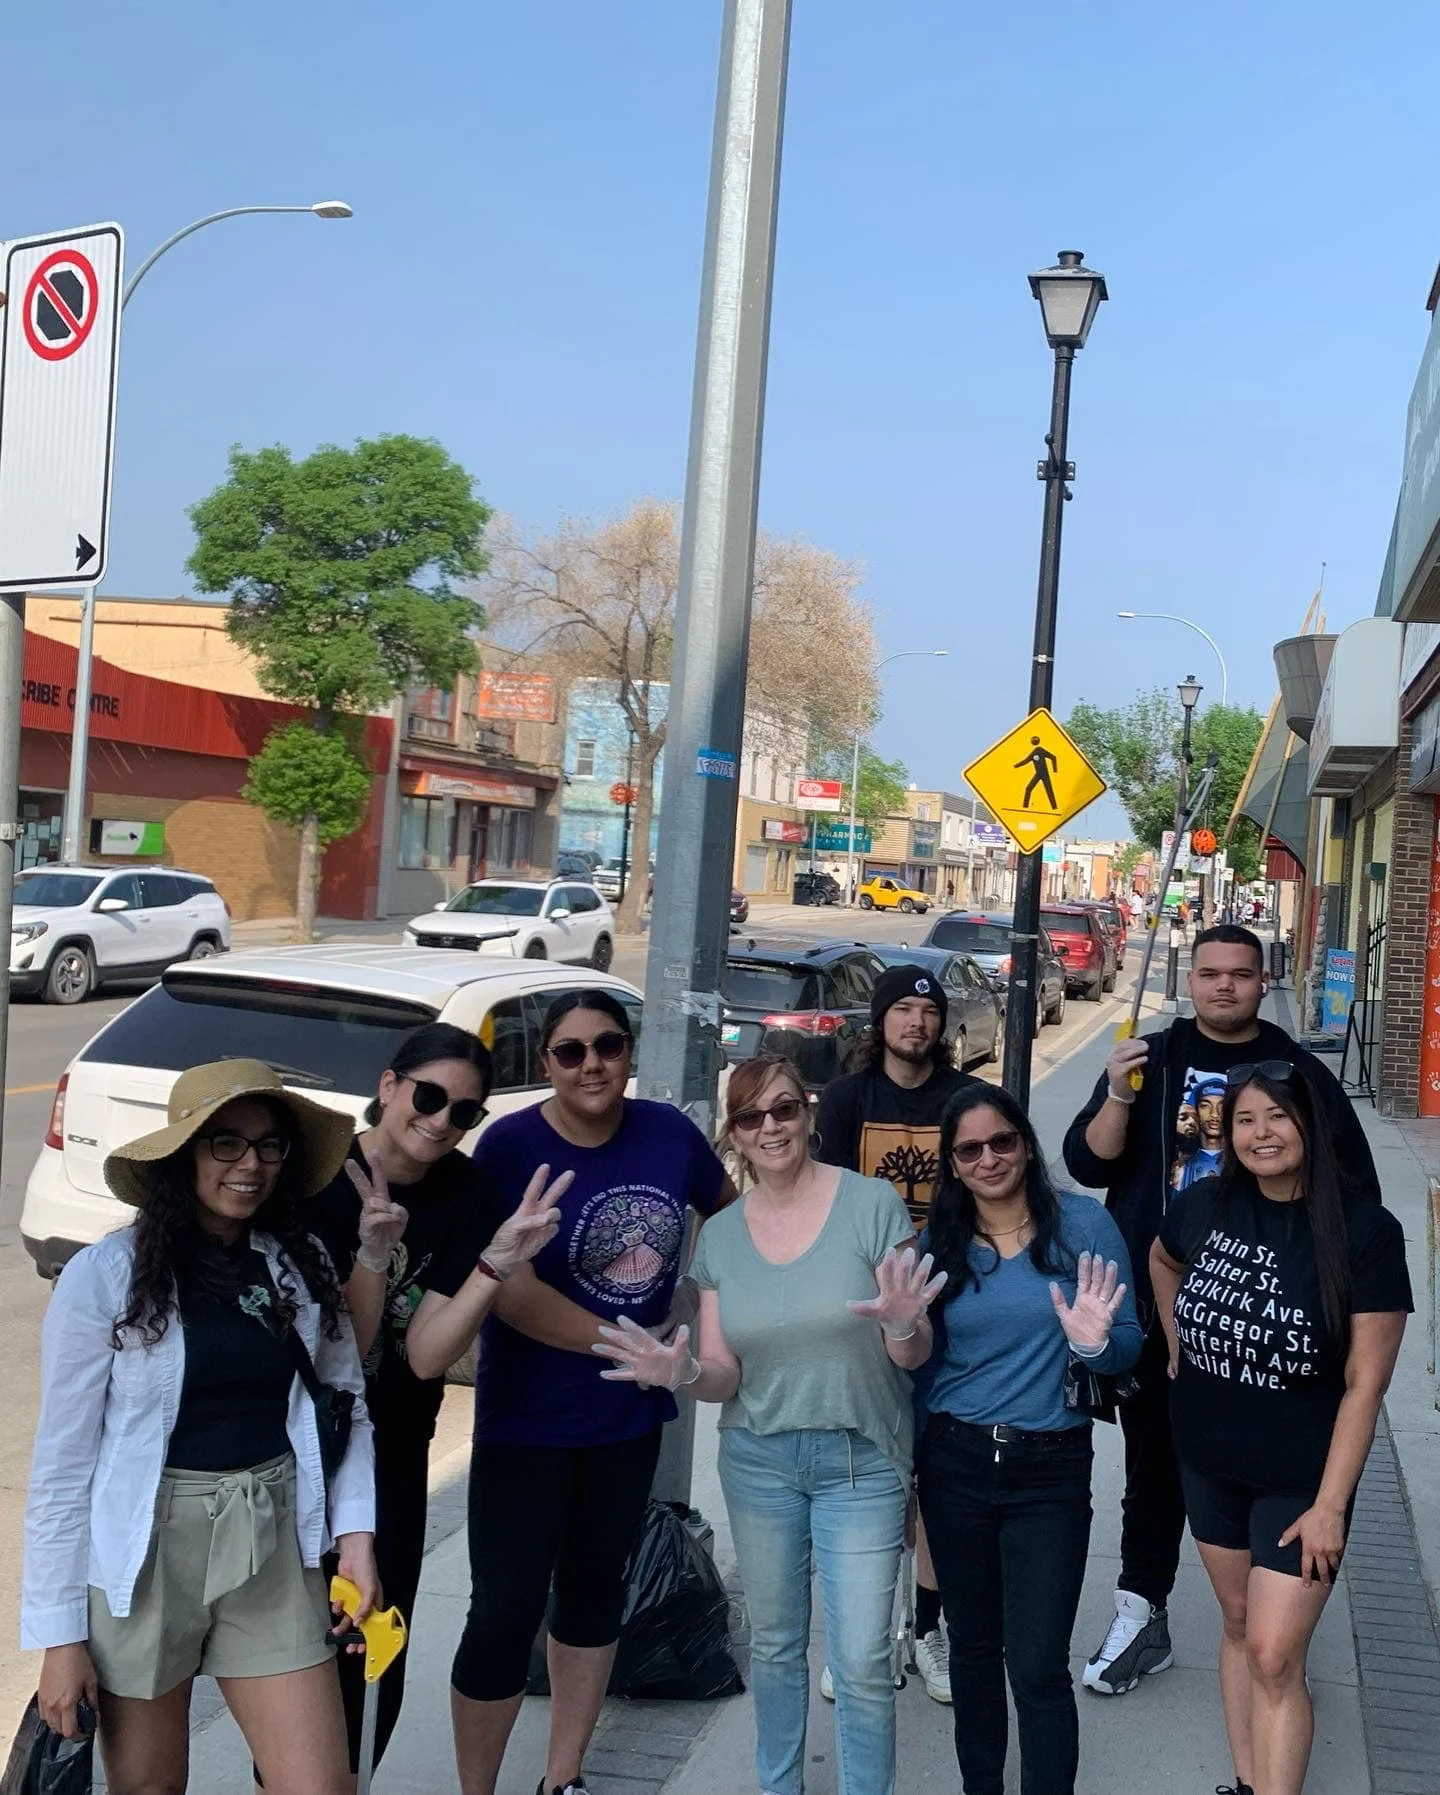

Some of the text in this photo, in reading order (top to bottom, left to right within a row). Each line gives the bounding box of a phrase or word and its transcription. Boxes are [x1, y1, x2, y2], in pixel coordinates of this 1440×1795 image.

[66, 688, 120, 718] CNTRE
[1326, 970, 1348, 982] NOW
[67, 1134, 98, 1147] EDGE
[567, 1218, 586, 1263] TOGETHER
[592, 1191, 606, 1203] END
[607, 1185, 627, 1195] THIS
[628, 1184, 670, 1199] NATIONAL
[1205, 1229, 1278, 1268] Main St.
[1194, 1251, 1283, 1295] Salter St.
[596, 1291, 626, 1306] LOVED
[1184, 1272, 1312, 1326] Selkirk Ave.
[1174, 1293, 1319, 1354] McGregor St.
[1181, 1342, 1287, 1390] uclid Ave.
[1268, 1352, 1318, 1375] Ave.
